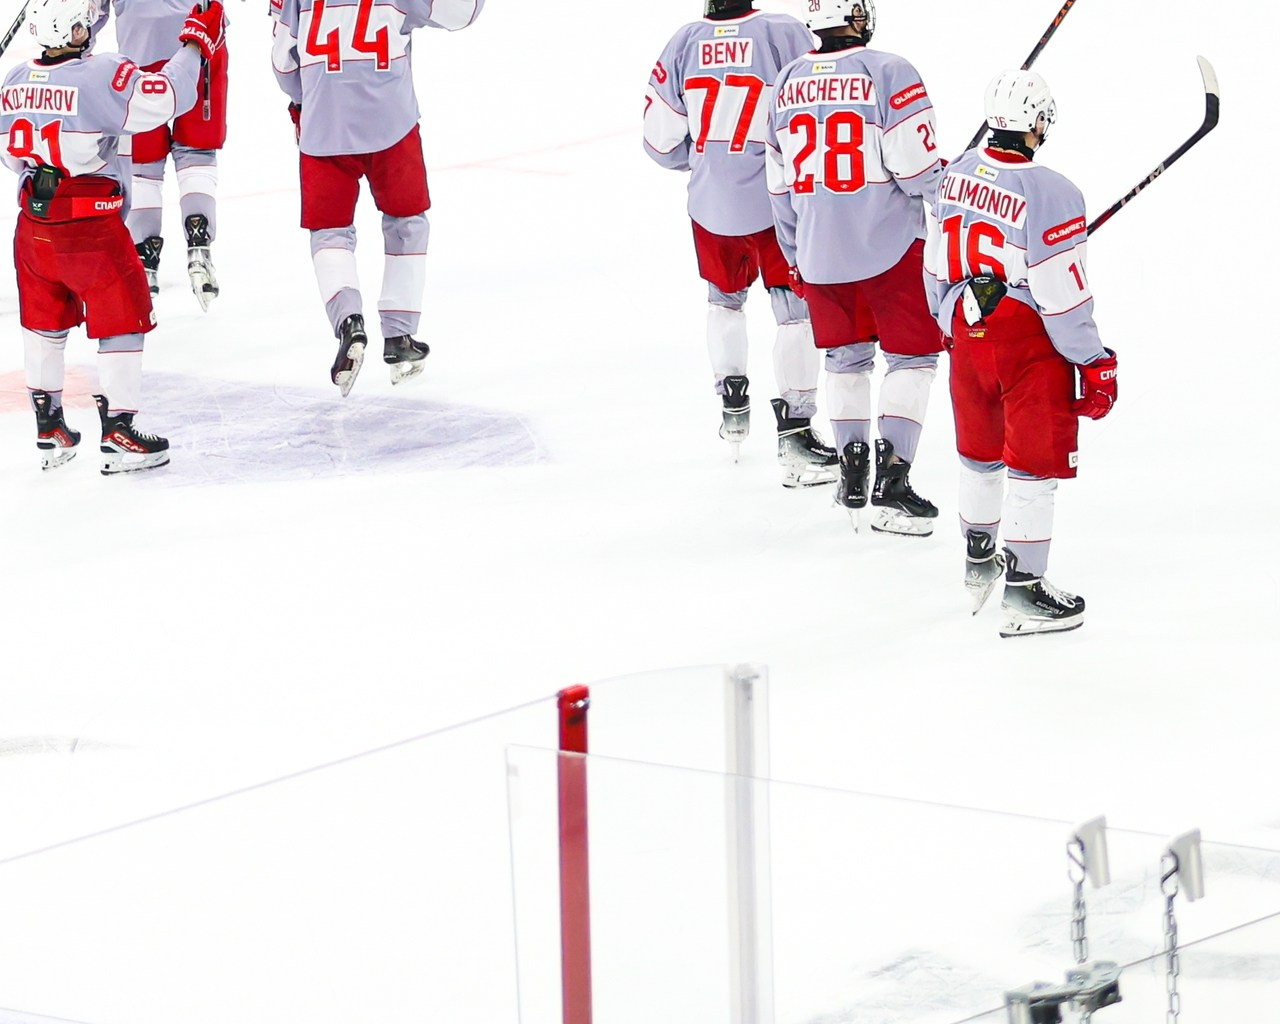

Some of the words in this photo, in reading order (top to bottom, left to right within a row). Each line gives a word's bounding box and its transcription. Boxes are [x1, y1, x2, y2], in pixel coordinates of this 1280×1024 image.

[701, 41, 750, 65] BENY
[1, 87, 76, 112] KOCHUROV
[776, 77, 874, 109] RAKCHEYEV
[684, 74, 766, 154] 77
[994, 116, 1007, 128] 16
[789, 111, 865, 194] 28
[917, 123, 936, 153] 2
[940, 176, 1027, 223] FILIMONOV
